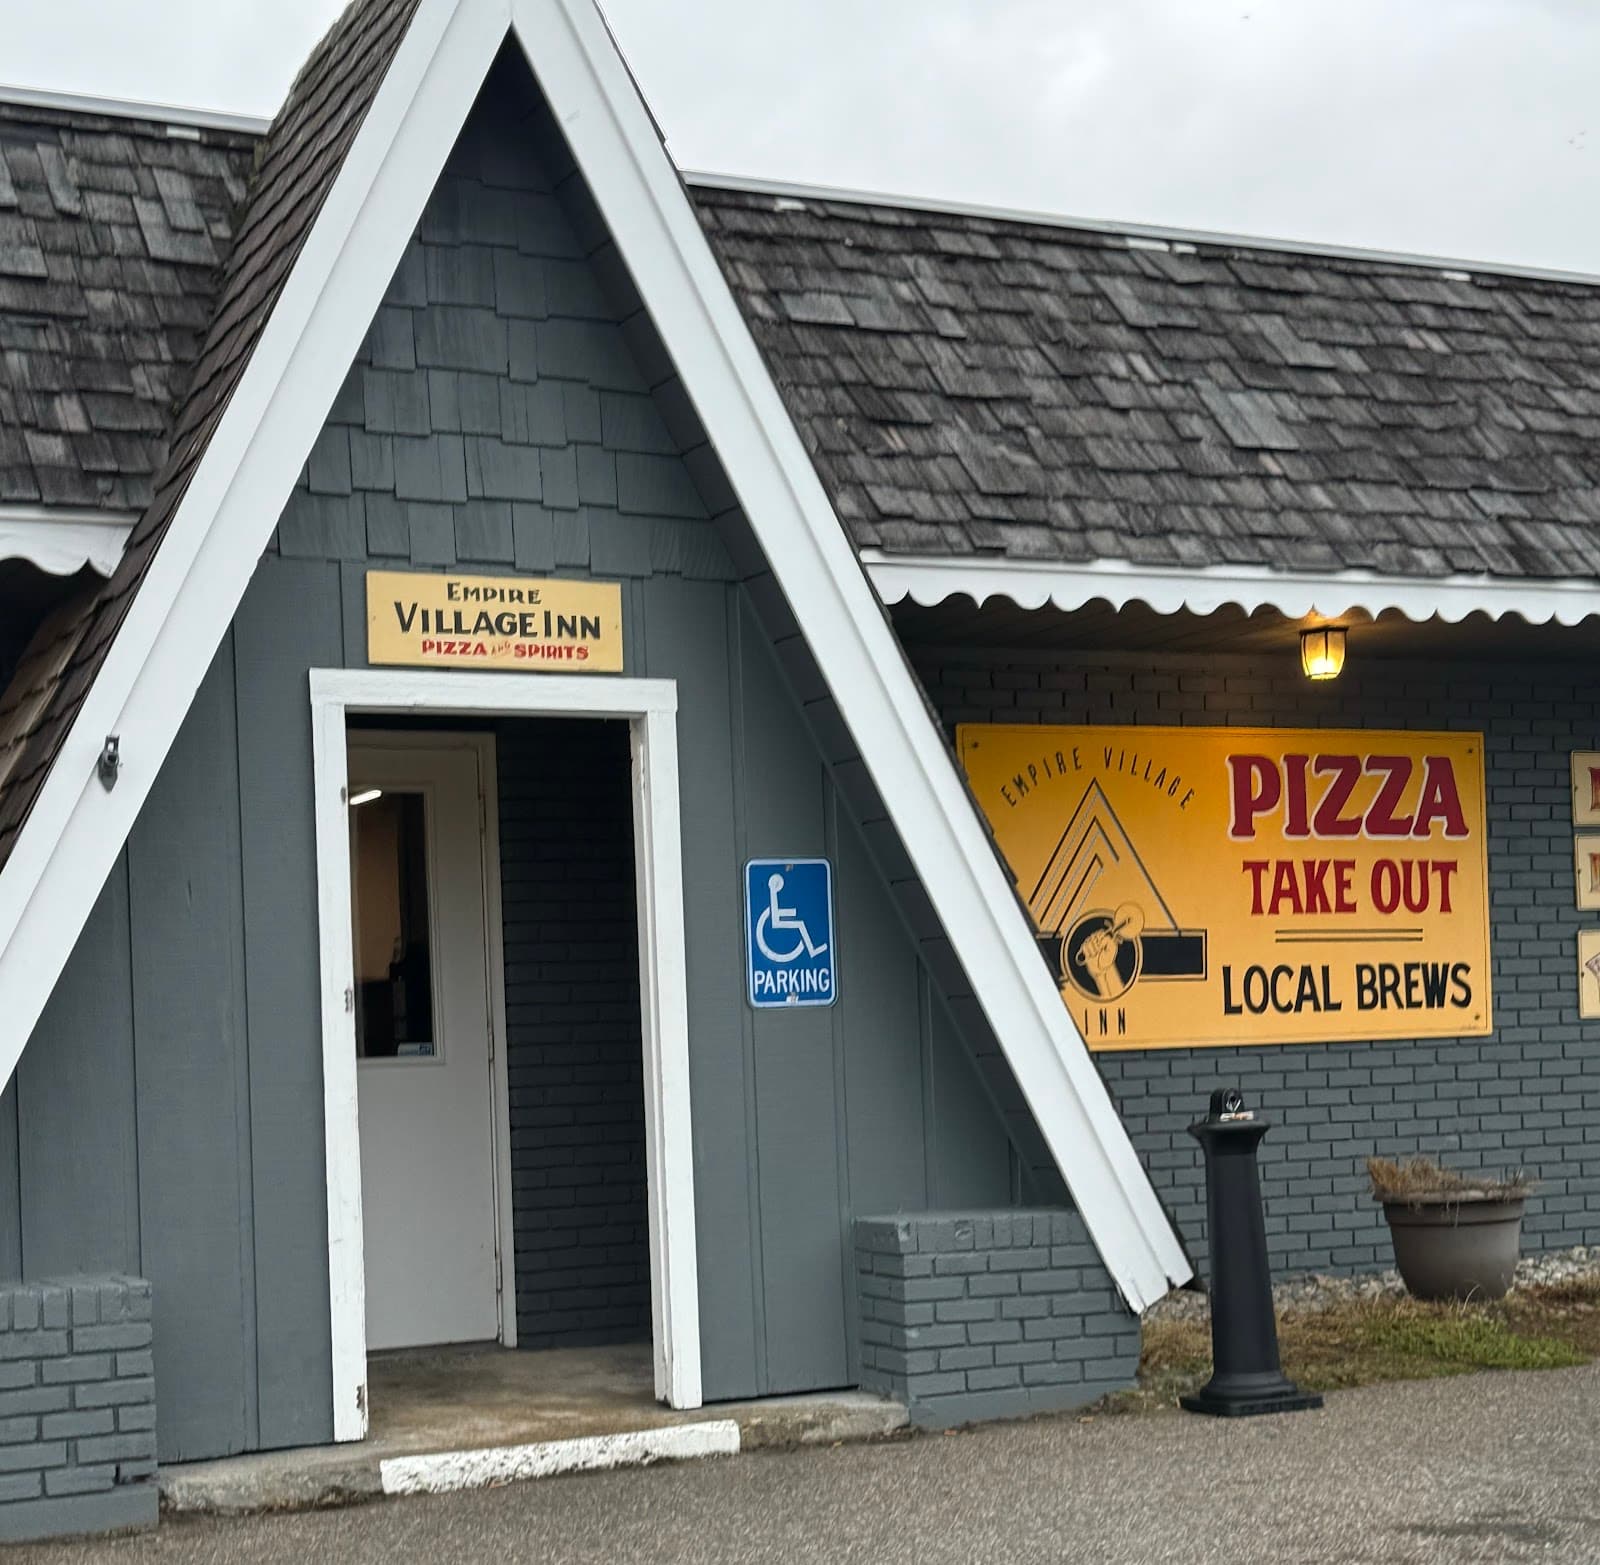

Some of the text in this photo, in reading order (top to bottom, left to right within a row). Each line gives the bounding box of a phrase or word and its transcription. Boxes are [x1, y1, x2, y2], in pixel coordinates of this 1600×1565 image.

[447, 581, 542, 605] EMPIRE
[394, 601, 600, 640] VILLAGE INN
[422, 638, 487, 657] PIZZA
[514, 643, 589, 661] SPIRITS
[1001, 746, 1195, 810] EMPIRE VILLAGE
[1225, 754, 1470, 841] PIZZA
[1242, 858, 1458, 916] TAKE OUT
[754, 967, 830, 995] PARKING
[1222, 962, 1472, 1016] LOCAL BREWS
[1084, 1007, 1126, 1036] INN
